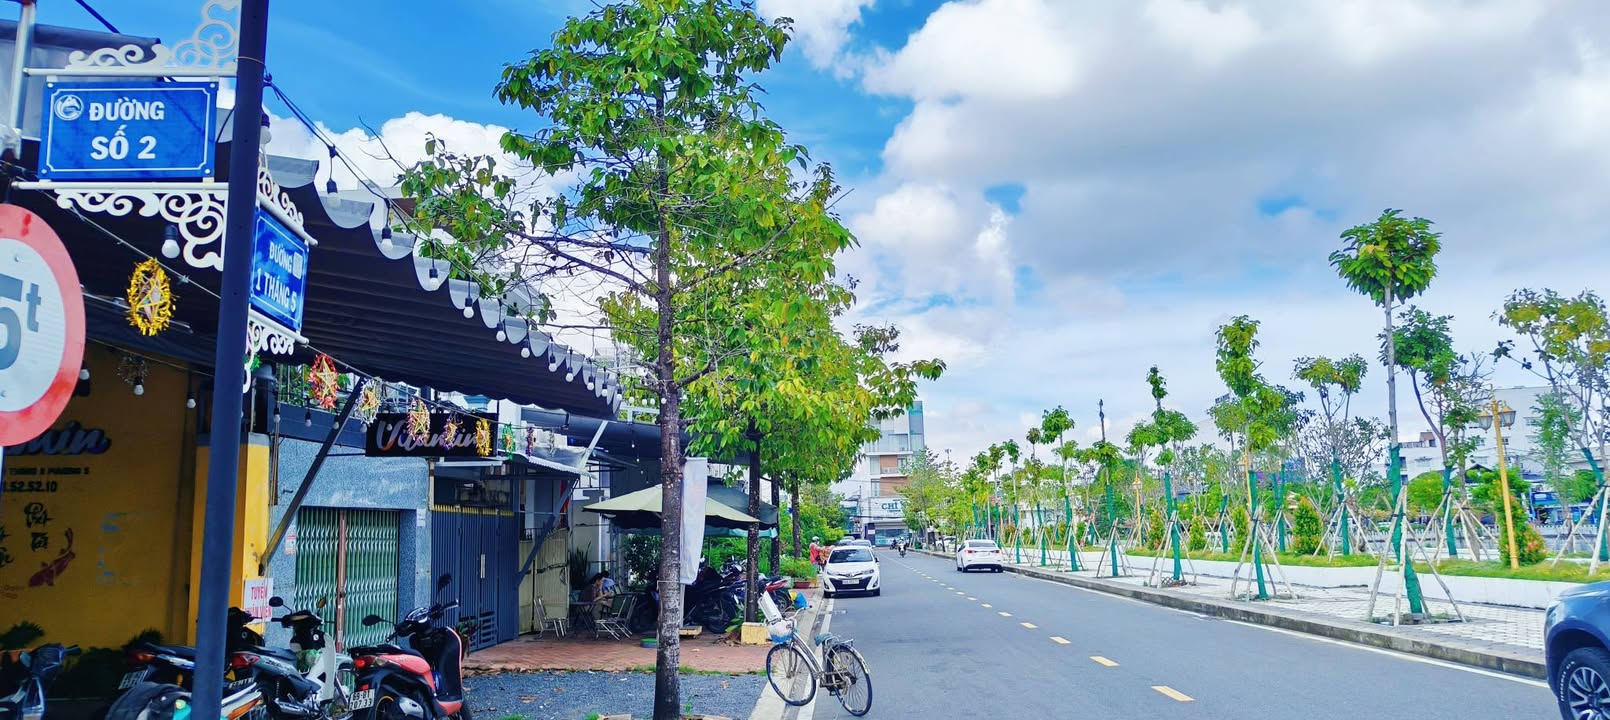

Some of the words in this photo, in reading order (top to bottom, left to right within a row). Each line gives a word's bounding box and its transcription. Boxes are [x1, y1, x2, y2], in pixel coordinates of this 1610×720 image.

[89, 96, 165, 121] ĐƯỜNG
[90, 124, 129, 160] SỐ
[137, 135, 157, 159] 2
[269, 240, 293, 274] ĐƯỜNG
[256, 268, 262, 291] 1
[264, 271, 290, 308] THÁNG
[290, 290, 297, 313] 5
